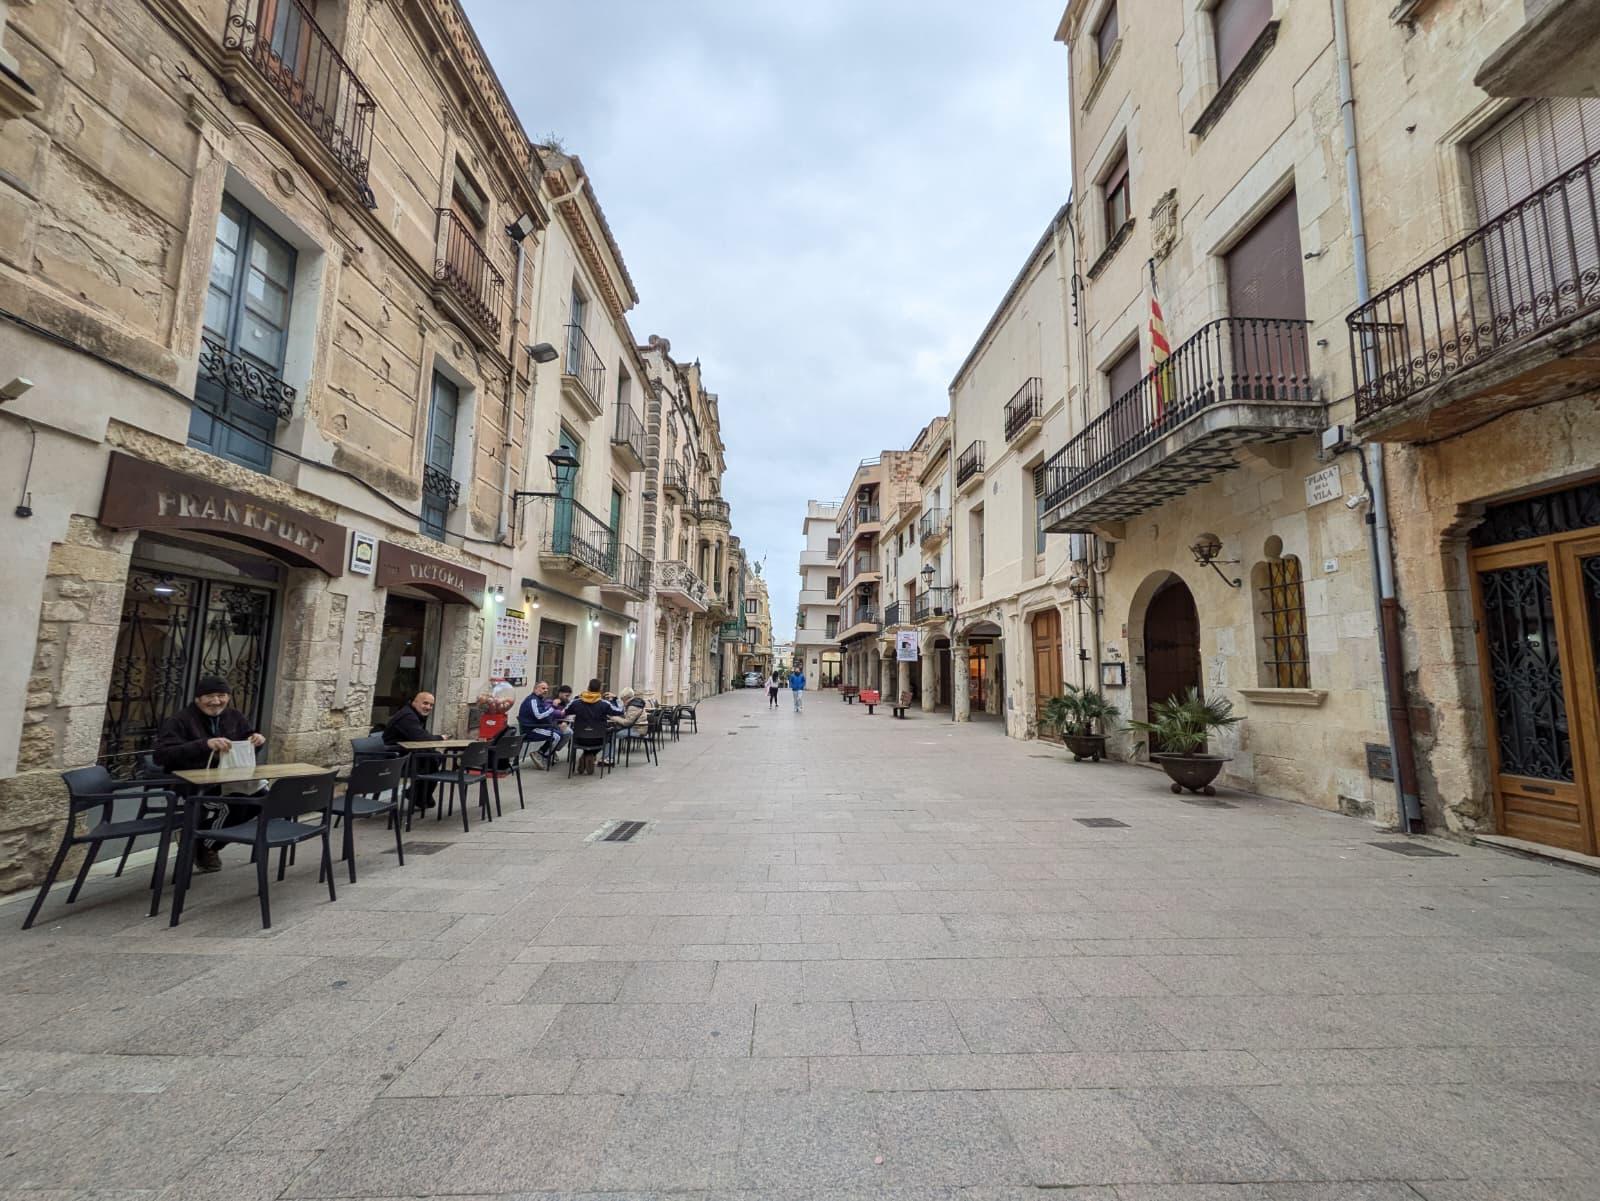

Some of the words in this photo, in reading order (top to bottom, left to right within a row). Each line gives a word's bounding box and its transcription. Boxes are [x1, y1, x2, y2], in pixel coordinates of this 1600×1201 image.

[1308, 470, 1334, 486] PLAÇA
[1313, 489, 1332, 500] VILA
[158, 491, 324, 553] FRANKFURT
[410, 564, 464, 591] VICTORIA
